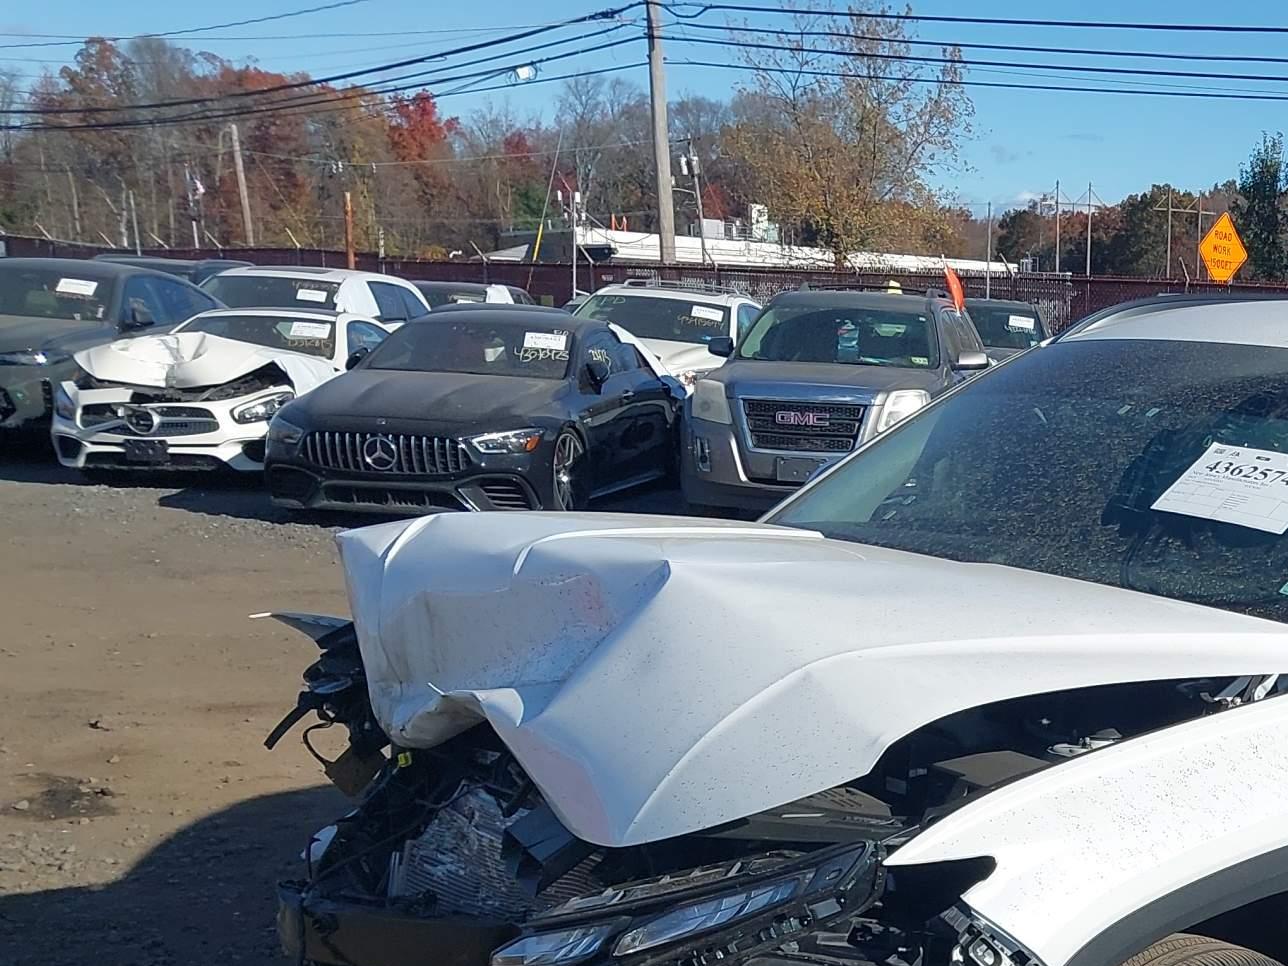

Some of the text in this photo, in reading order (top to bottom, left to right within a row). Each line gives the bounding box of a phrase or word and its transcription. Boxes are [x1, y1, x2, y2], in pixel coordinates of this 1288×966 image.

[1214, 230, 1232, 241] ROAD
[1213, 244, 1231, 256] WORK
[775, 410, 831, 427] GMC
